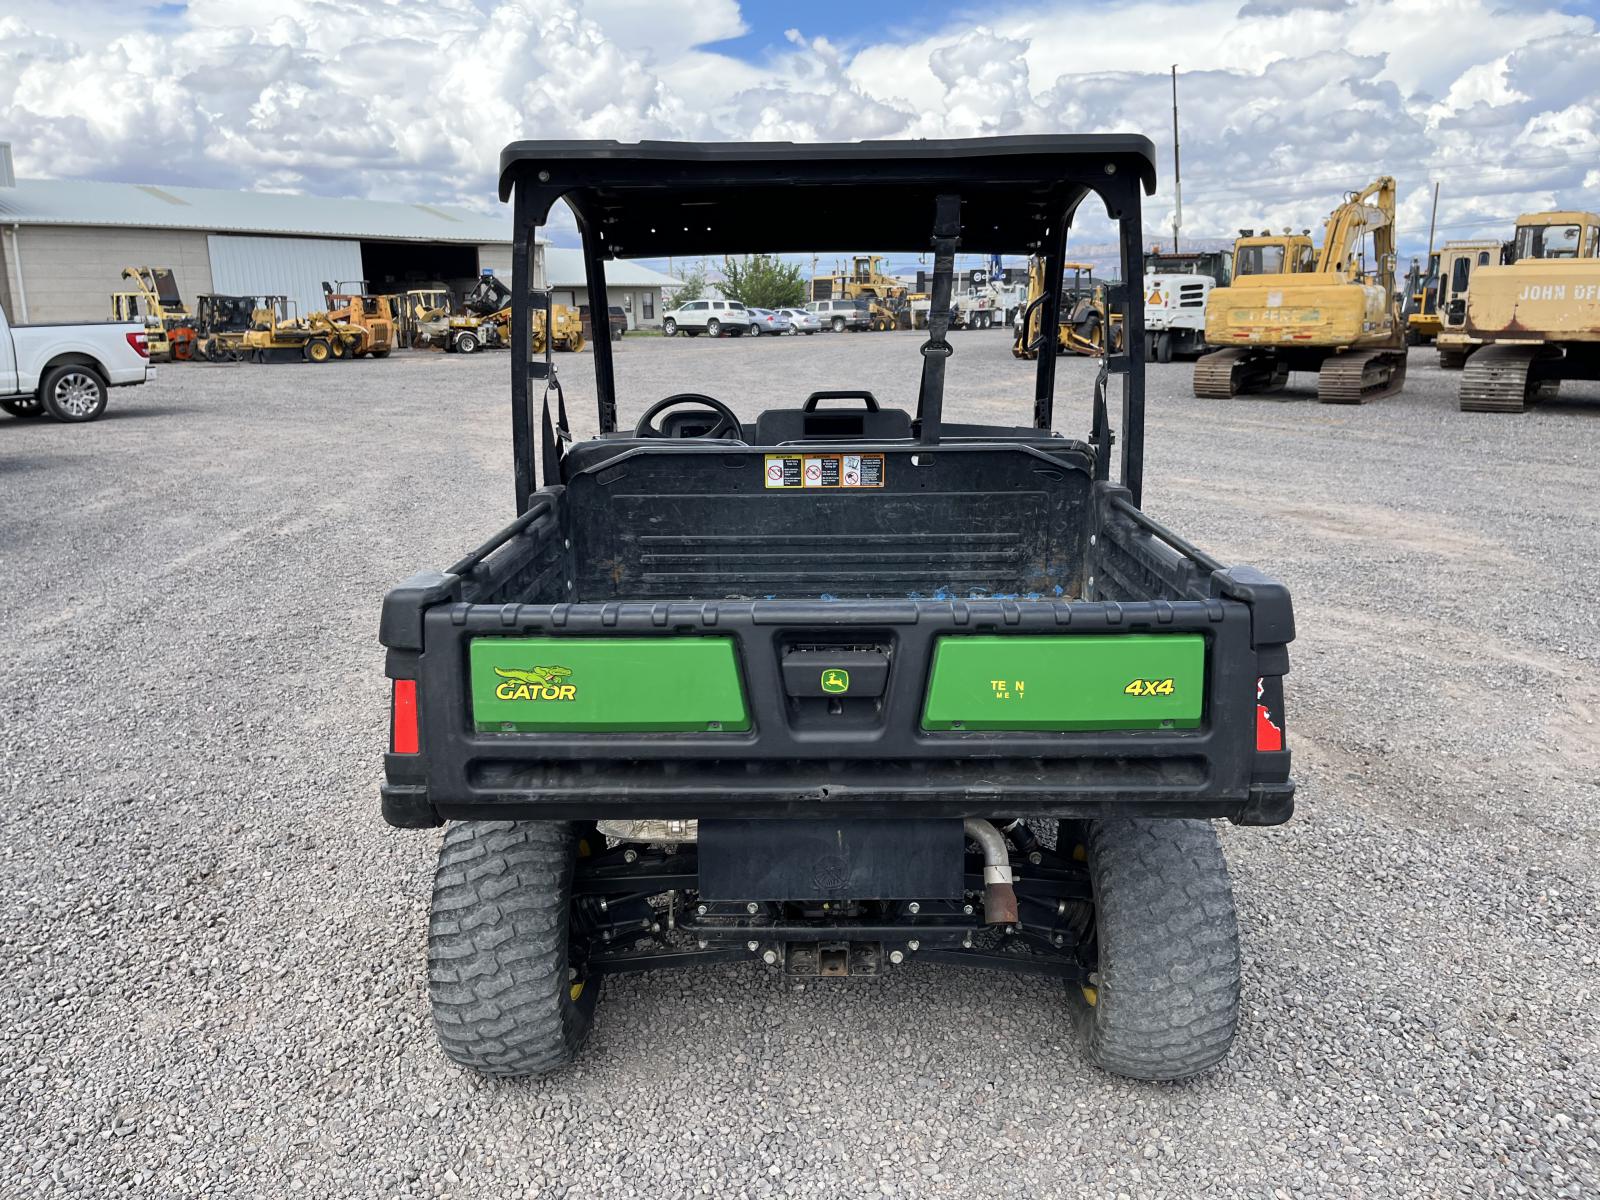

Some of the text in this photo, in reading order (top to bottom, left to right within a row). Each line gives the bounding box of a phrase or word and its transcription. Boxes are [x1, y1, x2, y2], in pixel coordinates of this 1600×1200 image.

[1519, 284, 1600, 301] JOHN DE
[495, 683, 577, 701] GATOR
